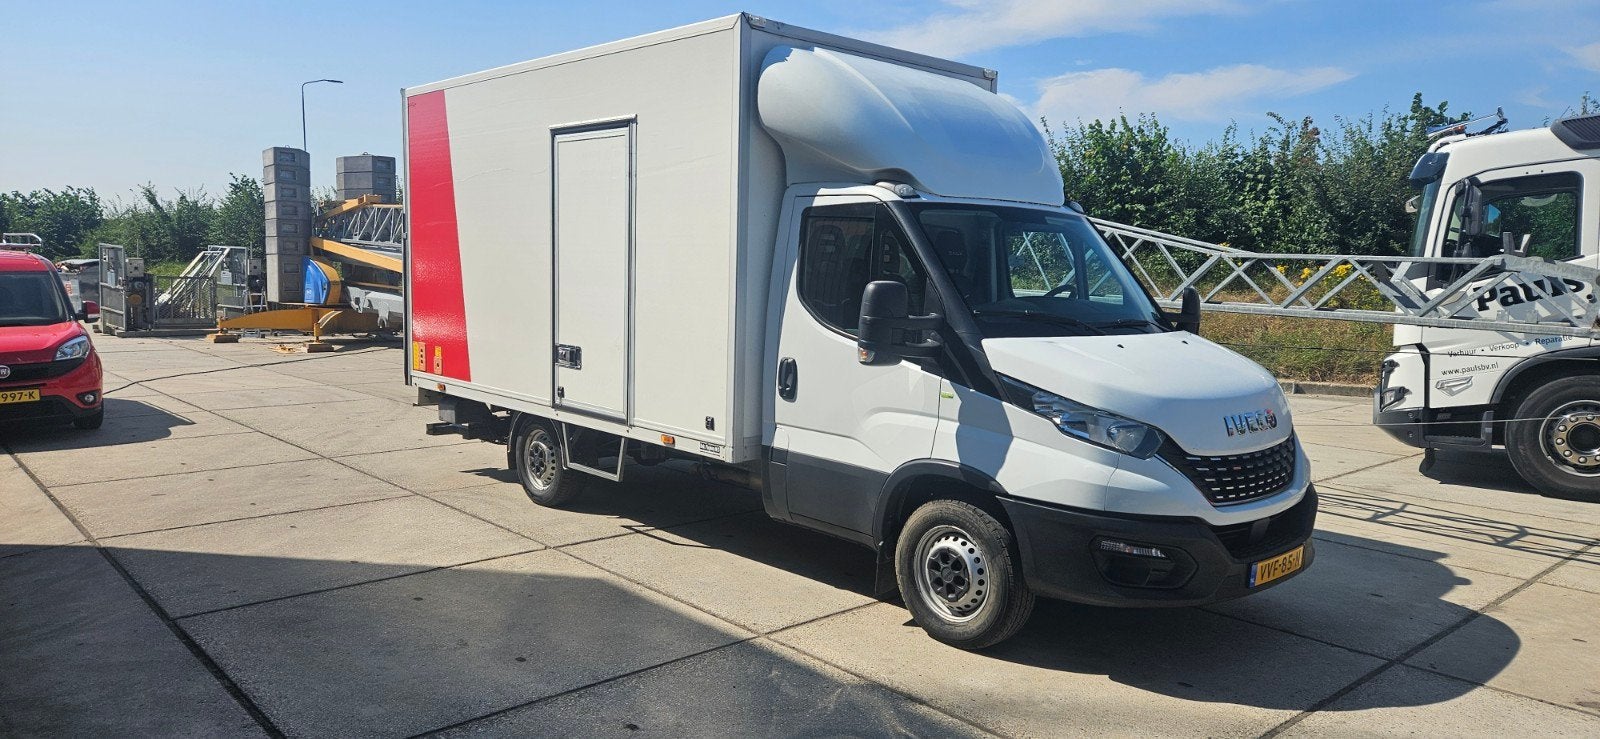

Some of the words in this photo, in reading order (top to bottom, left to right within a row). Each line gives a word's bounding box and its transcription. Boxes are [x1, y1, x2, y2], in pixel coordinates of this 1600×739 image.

[1489, 341, 1519, 351] Verkoop
[1441, 361, 1499, 376] www.paulsbv.nl
[1, 391, 36, 402] 997-K
[1223, 408, 1278, 437] IVECO
